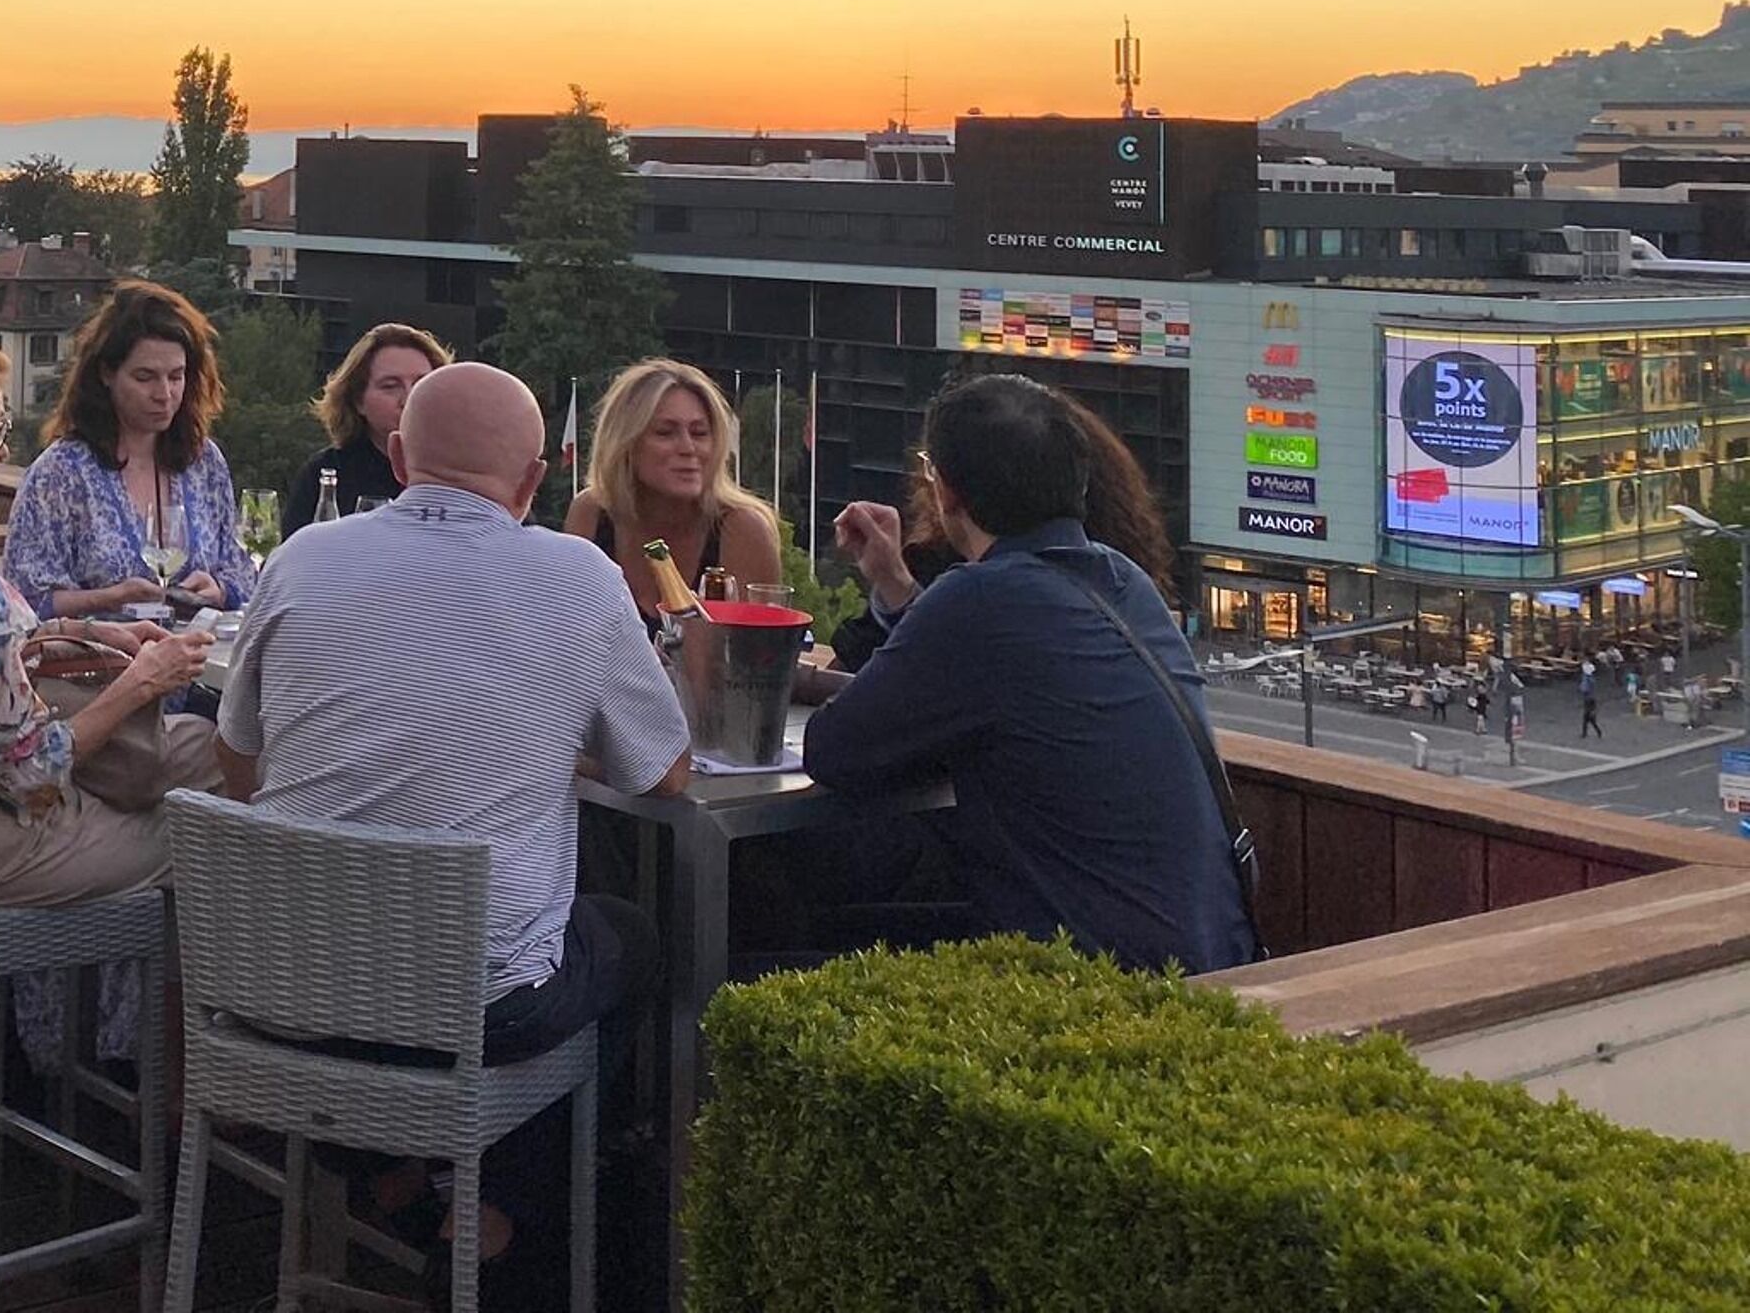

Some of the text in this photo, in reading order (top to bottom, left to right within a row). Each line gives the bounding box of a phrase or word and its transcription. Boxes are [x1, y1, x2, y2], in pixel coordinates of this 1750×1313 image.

[1110, 179, 1148, 188] CENTRE
[1114, 199, 1144, 209] VEVEY
[987, 233, 1165, 253] CENTRE COMMERCIAL
[1434, 361, 1486, 403] 5x
[1434, 400, 1487, 418] points
[1255, 436, 1307, 451] MANOR
[1648, 422, 1700, 451] MANOR
[1269, 448, 1308, 463] FOOD
[1263, 476, 1310, 494] MANORA
[1248, 513, 1315, 534] MANOR
[1469, 513, 1522, 531] MANOR
